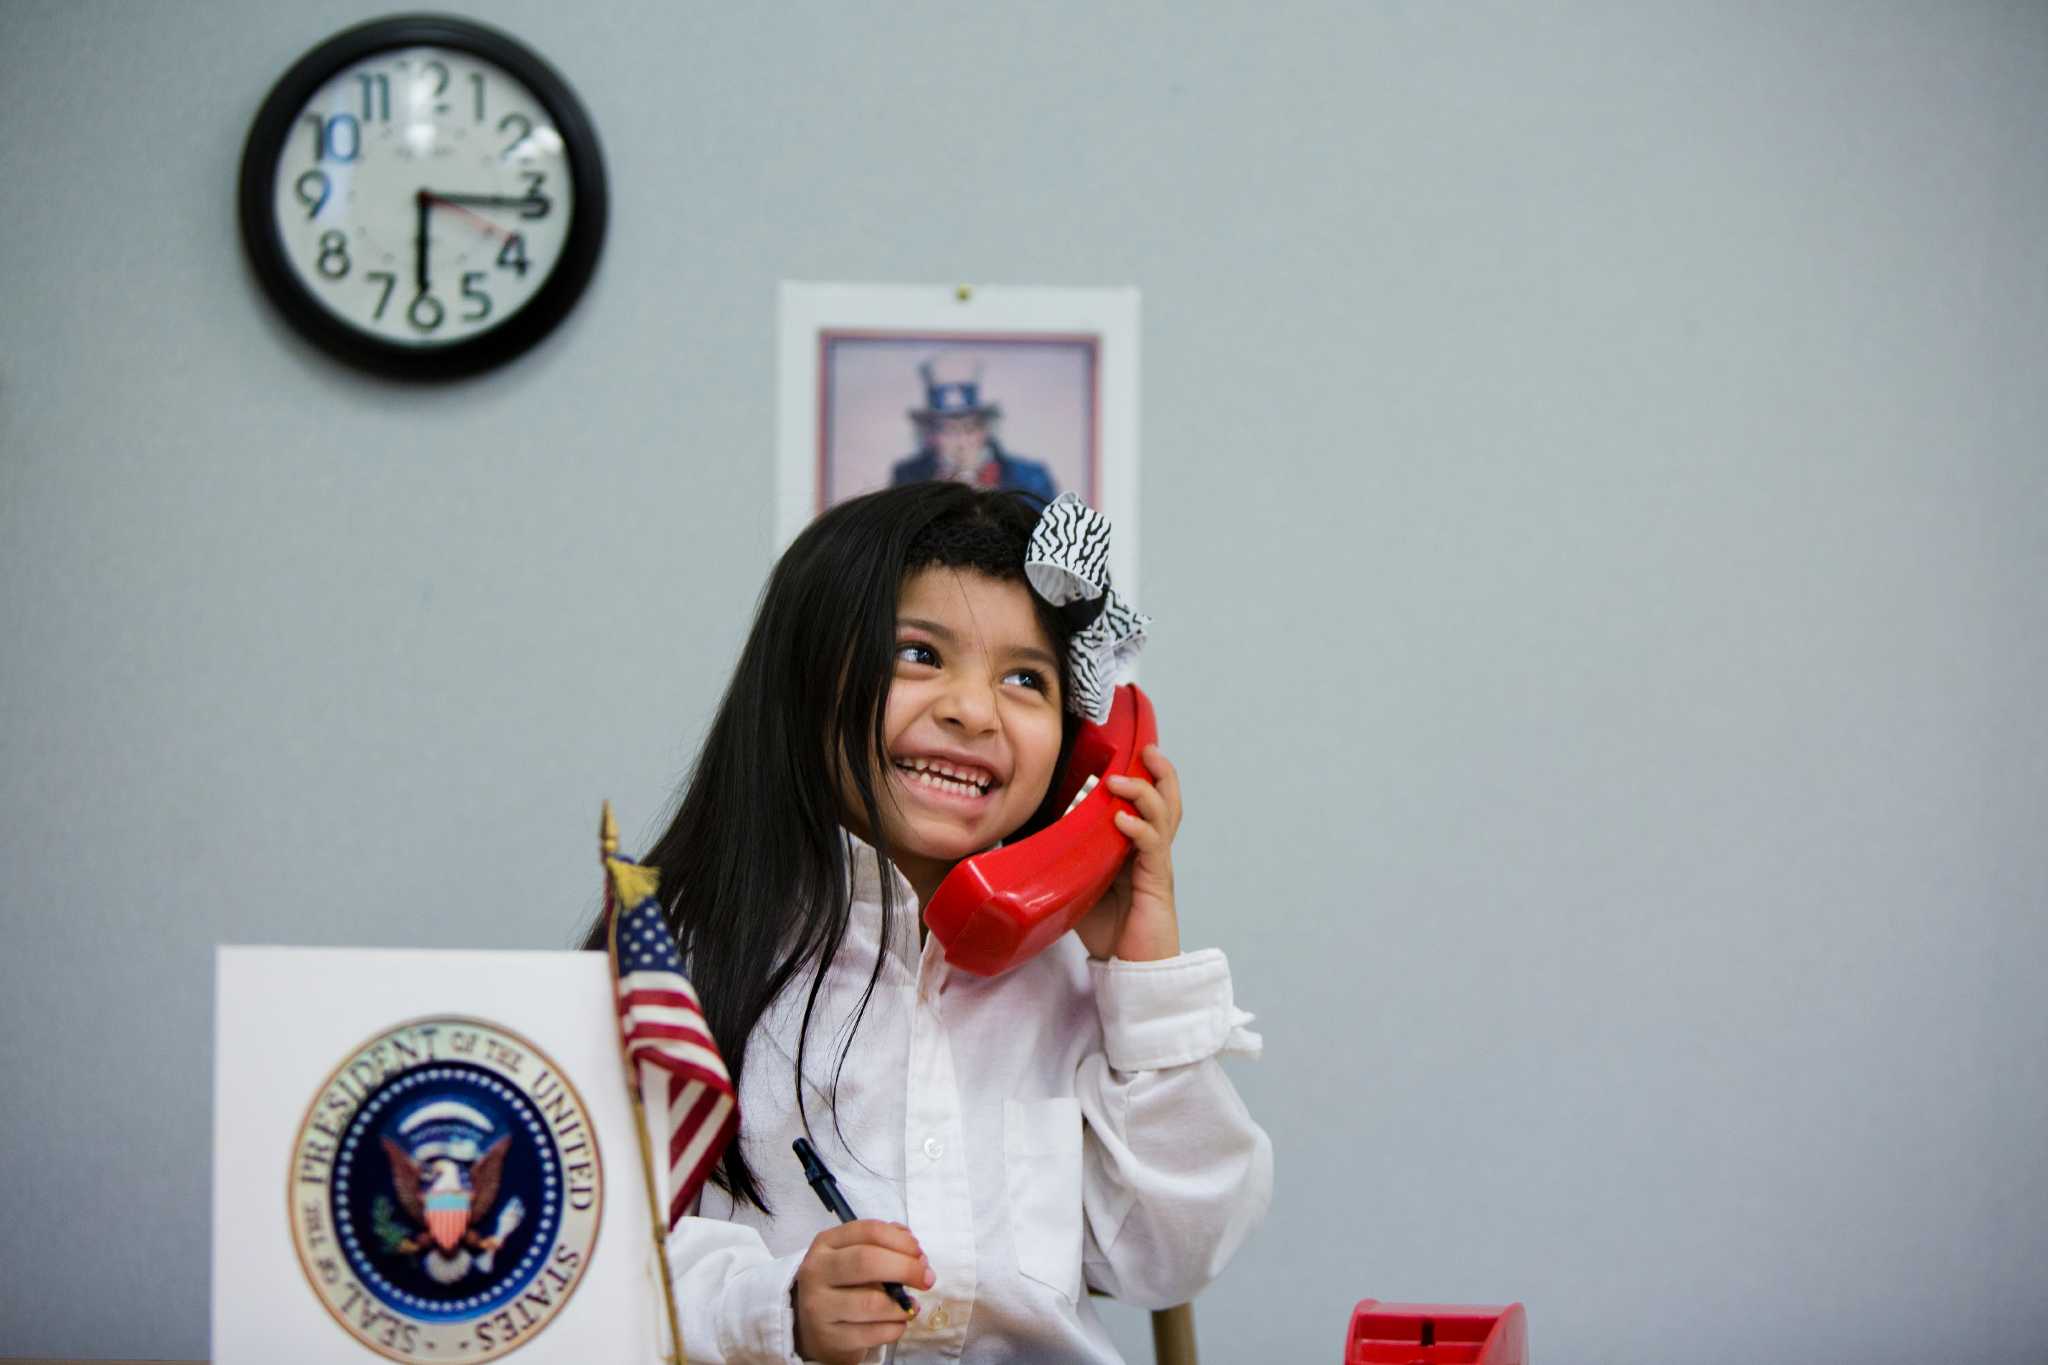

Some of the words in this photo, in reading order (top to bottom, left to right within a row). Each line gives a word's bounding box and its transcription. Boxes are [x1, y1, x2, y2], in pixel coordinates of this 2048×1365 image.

[356, 72, 391, 122] 11
[468, 71, 486, 123] 1
[303, 113, 361, 163] 10
[497, 112, 535, 165] 2
[295, 169, 332, 221] 9
[519, 170, 552, 220] 3
[317, 230, 351, 280] 8
[496, 232, 530, 277] 4
[366, 272, 396, 321] 7
[406, 286, 446, 333] 6
[461, 272, 493, 322] 5
[299, 1026, 438, 1184] PRESIDENT
[531, 1070, 594, 1211] UNITED
[341, 1281, 420, 1354] SEAL
[475, 1243, 580, 1351] STATES
